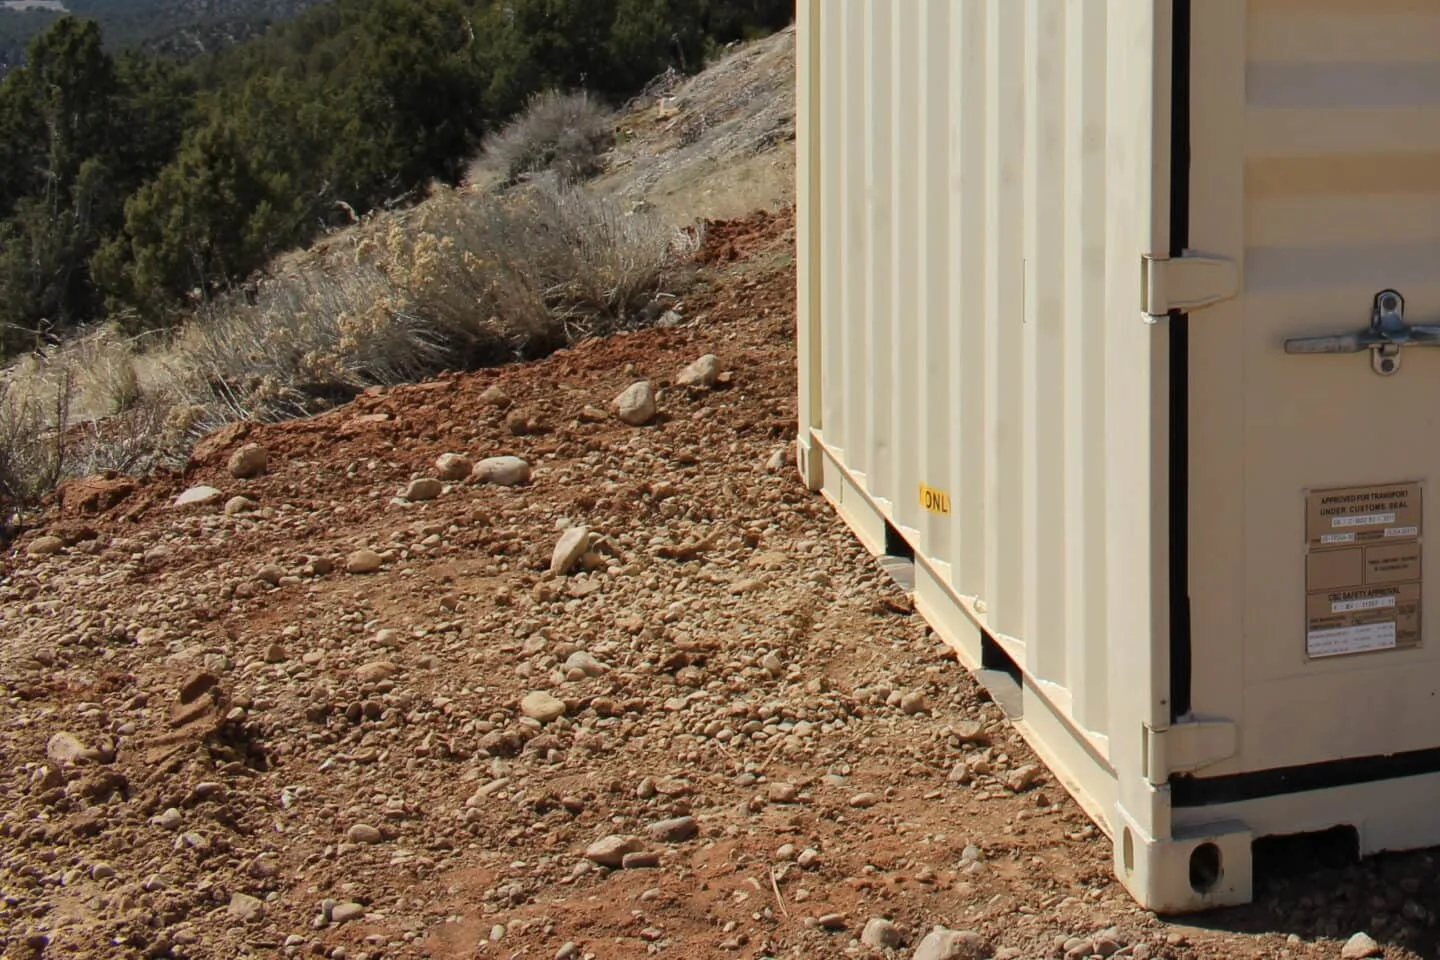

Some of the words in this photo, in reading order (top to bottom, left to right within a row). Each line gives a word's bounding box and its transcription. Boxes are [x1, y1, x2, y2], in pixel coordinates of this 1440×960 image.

[1320, 506, 1346, 516] UNDER
[1349, 503, 1386, 513] CUSTOMS
[1389, 501, 1409, 510] SEAL
